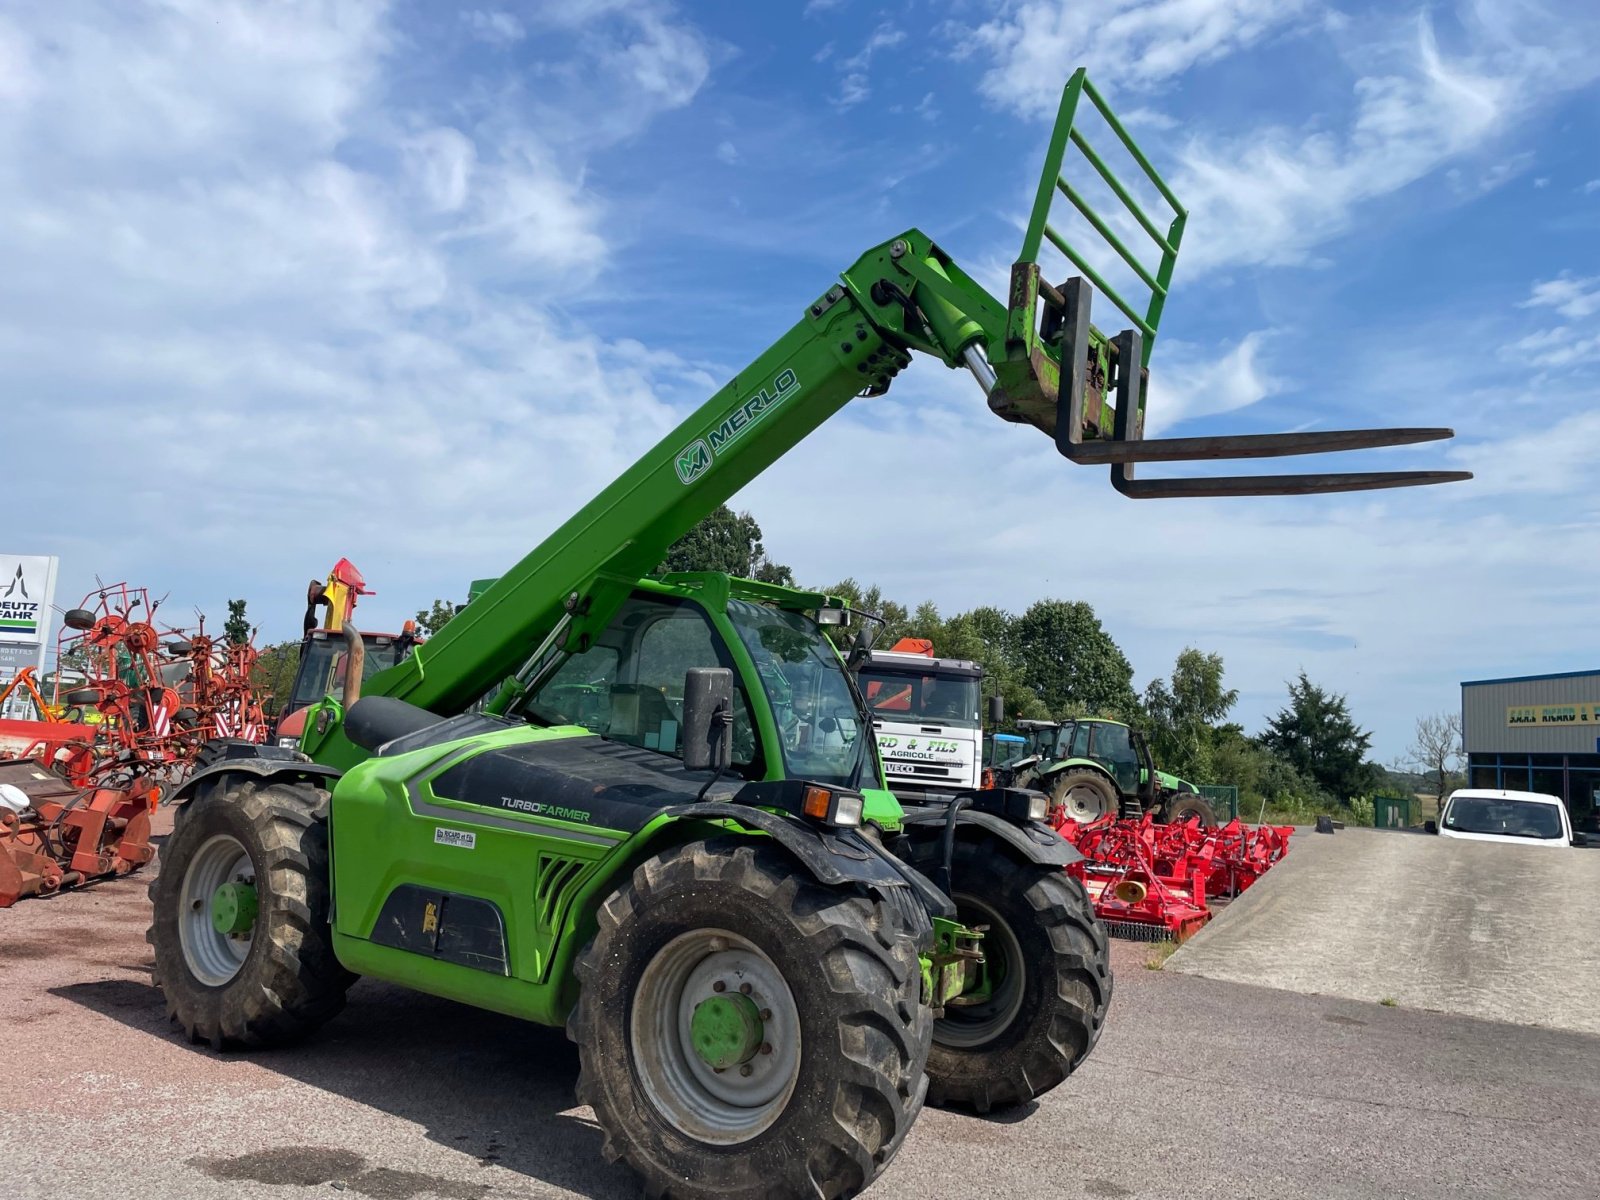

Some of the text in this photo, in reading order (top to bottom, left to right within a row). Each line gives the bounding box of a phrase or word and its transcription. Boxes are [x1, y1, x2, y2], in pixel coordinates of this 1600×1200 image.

[708, 368, 797, 450] MERLO
[0, 601, 38, 611] EUTZ
[907, 739, 918, 750] &
[926, 741, 959, 753] FILS
[890, 750, 934, 760] AGRICOLE
[884, 763, 915, 774] IVECO
[501, 796, 590, 821] TURBOFARMER
